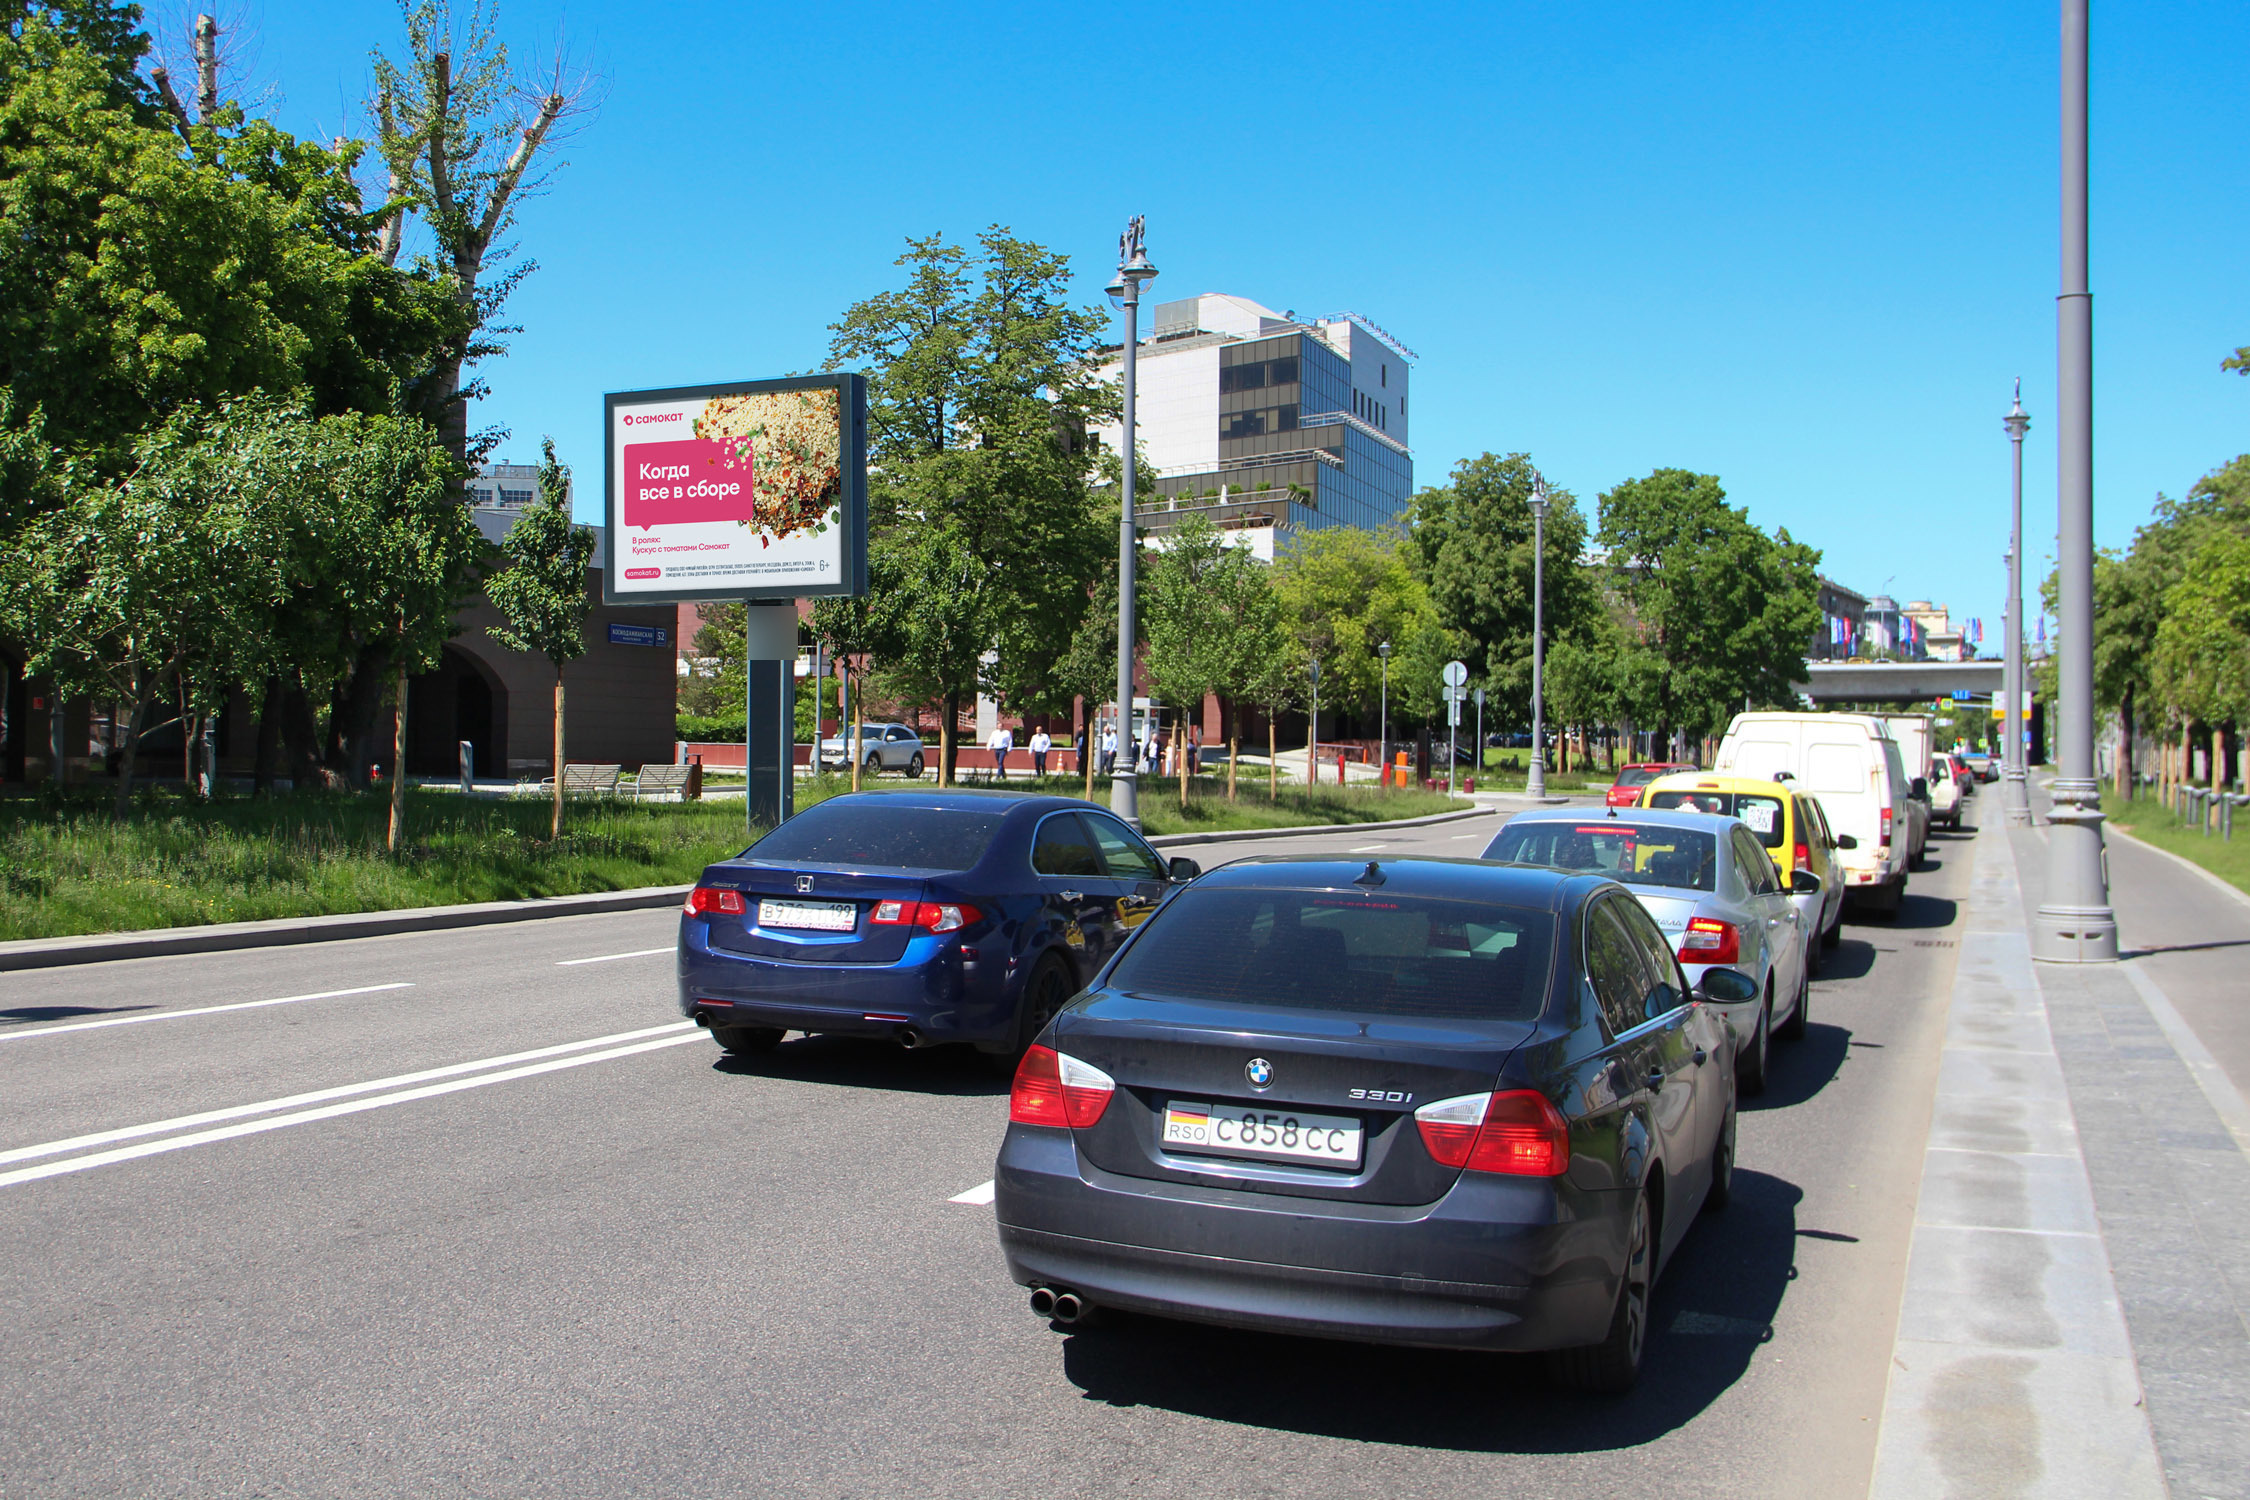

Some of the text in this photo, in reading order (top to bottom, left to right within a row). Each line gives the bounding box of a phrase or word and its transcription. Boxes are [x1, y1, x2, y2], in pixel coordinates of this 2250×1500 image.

[635, 412, 683, 425] самокат
[639, 463, 689, 481] Когда
[639, 479, 740, 501] все в сборе
[632, 537, 661, 546] В ролях:
[632, 546, 657, 556] Кускус
[663, 544, 698, 553] томатами
[698, 542, 730, 551] Самокат
[819, 559, 831, 572] 6+
[626, 568, 659, 578] samokat.ru
[656, 631, 665, 641] 52
[1169, 1124, 1206, 1141] RSO
